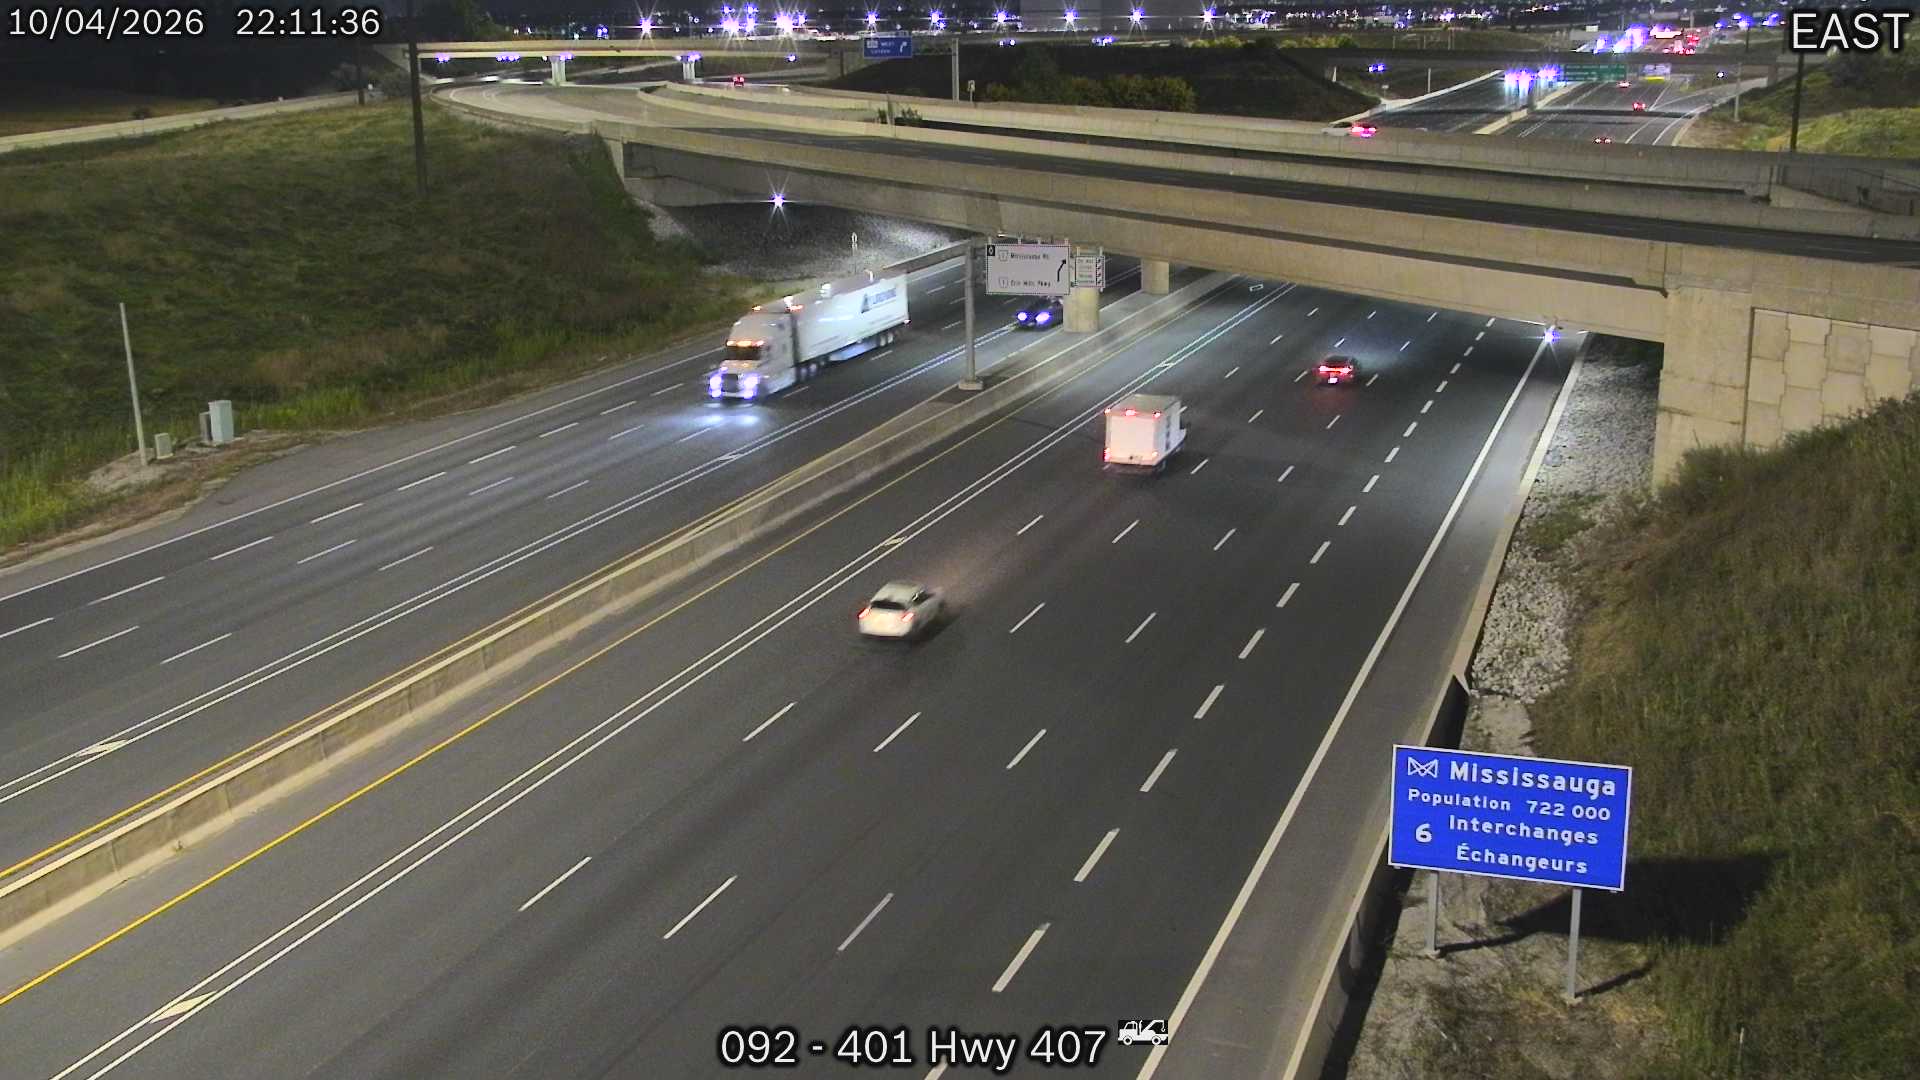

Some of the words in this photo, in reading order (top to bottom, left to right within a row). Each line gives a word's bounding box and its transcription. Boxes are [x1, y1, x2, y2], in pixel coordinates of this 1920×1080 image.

[1449, 760, 1617, 800] Mississauga
[1408, 788, 1511, 811] Population
[1525, 800, 1565, 817] 722
[1571, 804, 1611, 821] 000
[1415, 823, 1433, 843] 6
[1448, 814, 1600, 847] Interchanges
[1456, 842, 1589, 874] Échangeurs
